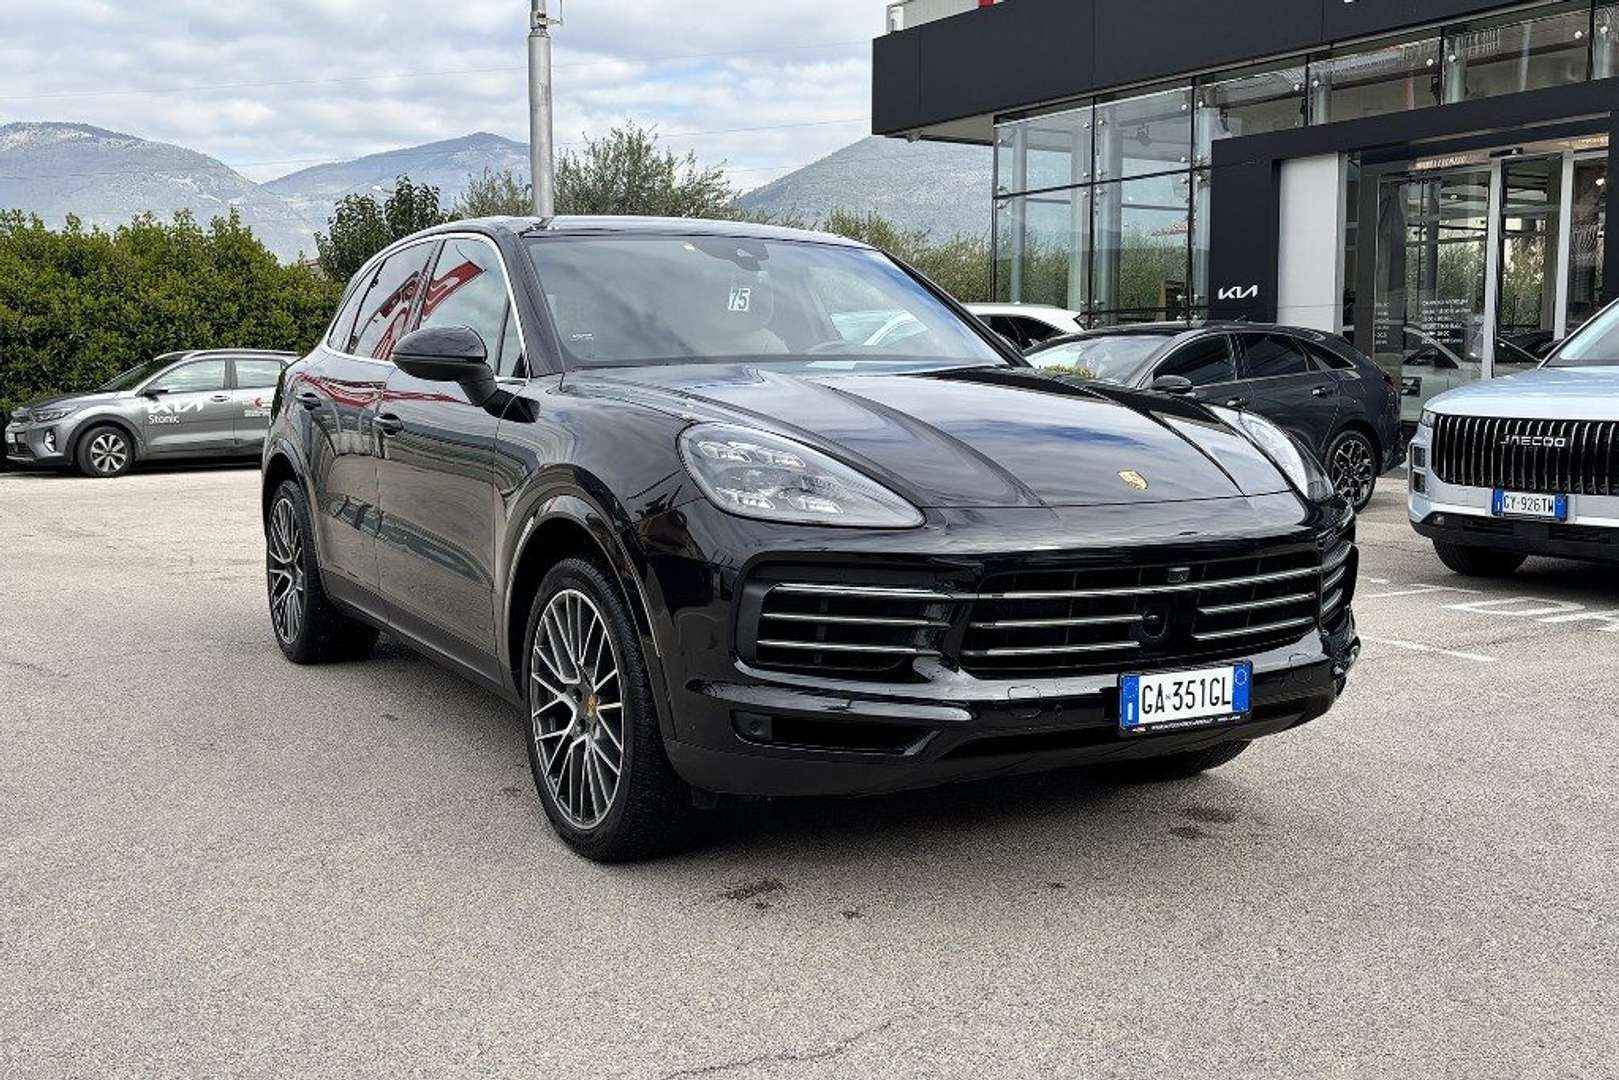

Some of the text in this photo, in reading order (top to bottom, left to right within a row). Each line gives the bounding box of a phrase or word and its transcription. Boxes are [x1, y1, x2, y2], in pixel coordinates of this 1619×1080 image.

[728, 287, 751, 311] 75
[148, 414, 181, 425] Stonic
[1500, 435, 1566, 447] JAECOO
